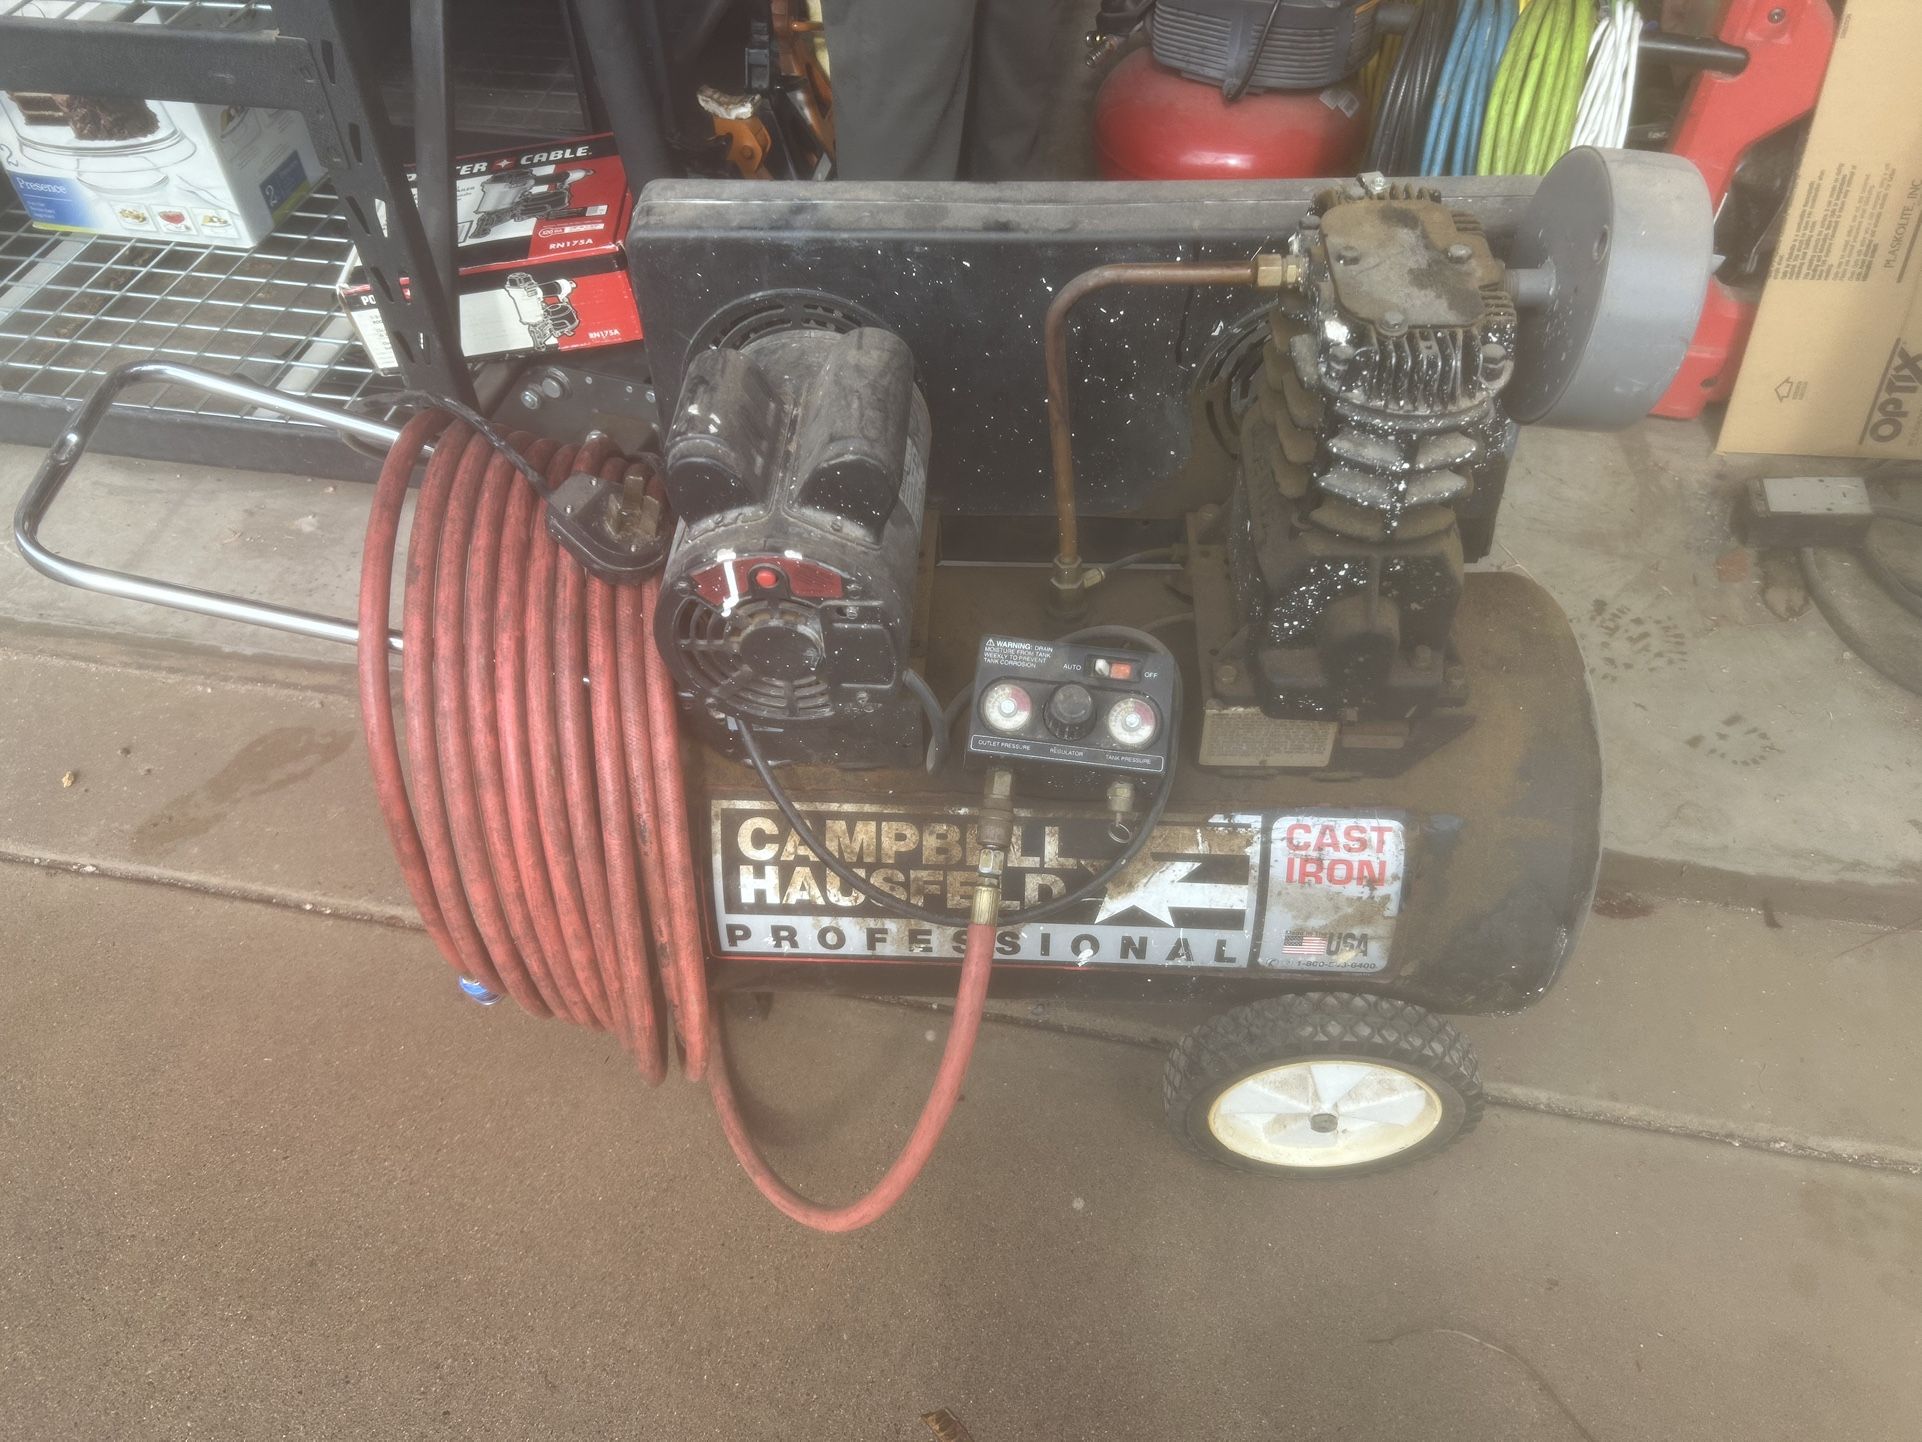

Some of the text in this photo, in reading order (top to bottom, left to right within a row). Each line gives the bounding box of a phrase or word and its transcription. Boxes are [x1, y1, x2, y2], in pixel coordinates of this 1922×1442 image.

[520, 145, 590, 166] CABLE
[16, 177, 67, 194] Presence
[548, 238, 593, 250] RN175A
[588, 329, 621, 339] RN175A
[996, 640, 1033, 650] WARNING:
[983, 651, 1008, 659] WEEKLY
[1018, 655, 1046, 664] PREVENT
[983, 657, 1036, 668] TANK CORROSION
[1063, 663, 1158, 679] AUTO OFF
[978, 739, 1031, 751] OUTLET PRESSURE
[1049, 748, 1083, 757] REGULATOR
[1121, 756, 1151, 765] PRESSURE
[1286, 823, 1393, 854] CAST
[1286, 857, 1387, 887] IRON
[725, 923, 1238, 964] PROFESSIONAL
[1325, 932, 1368, 957] USA
